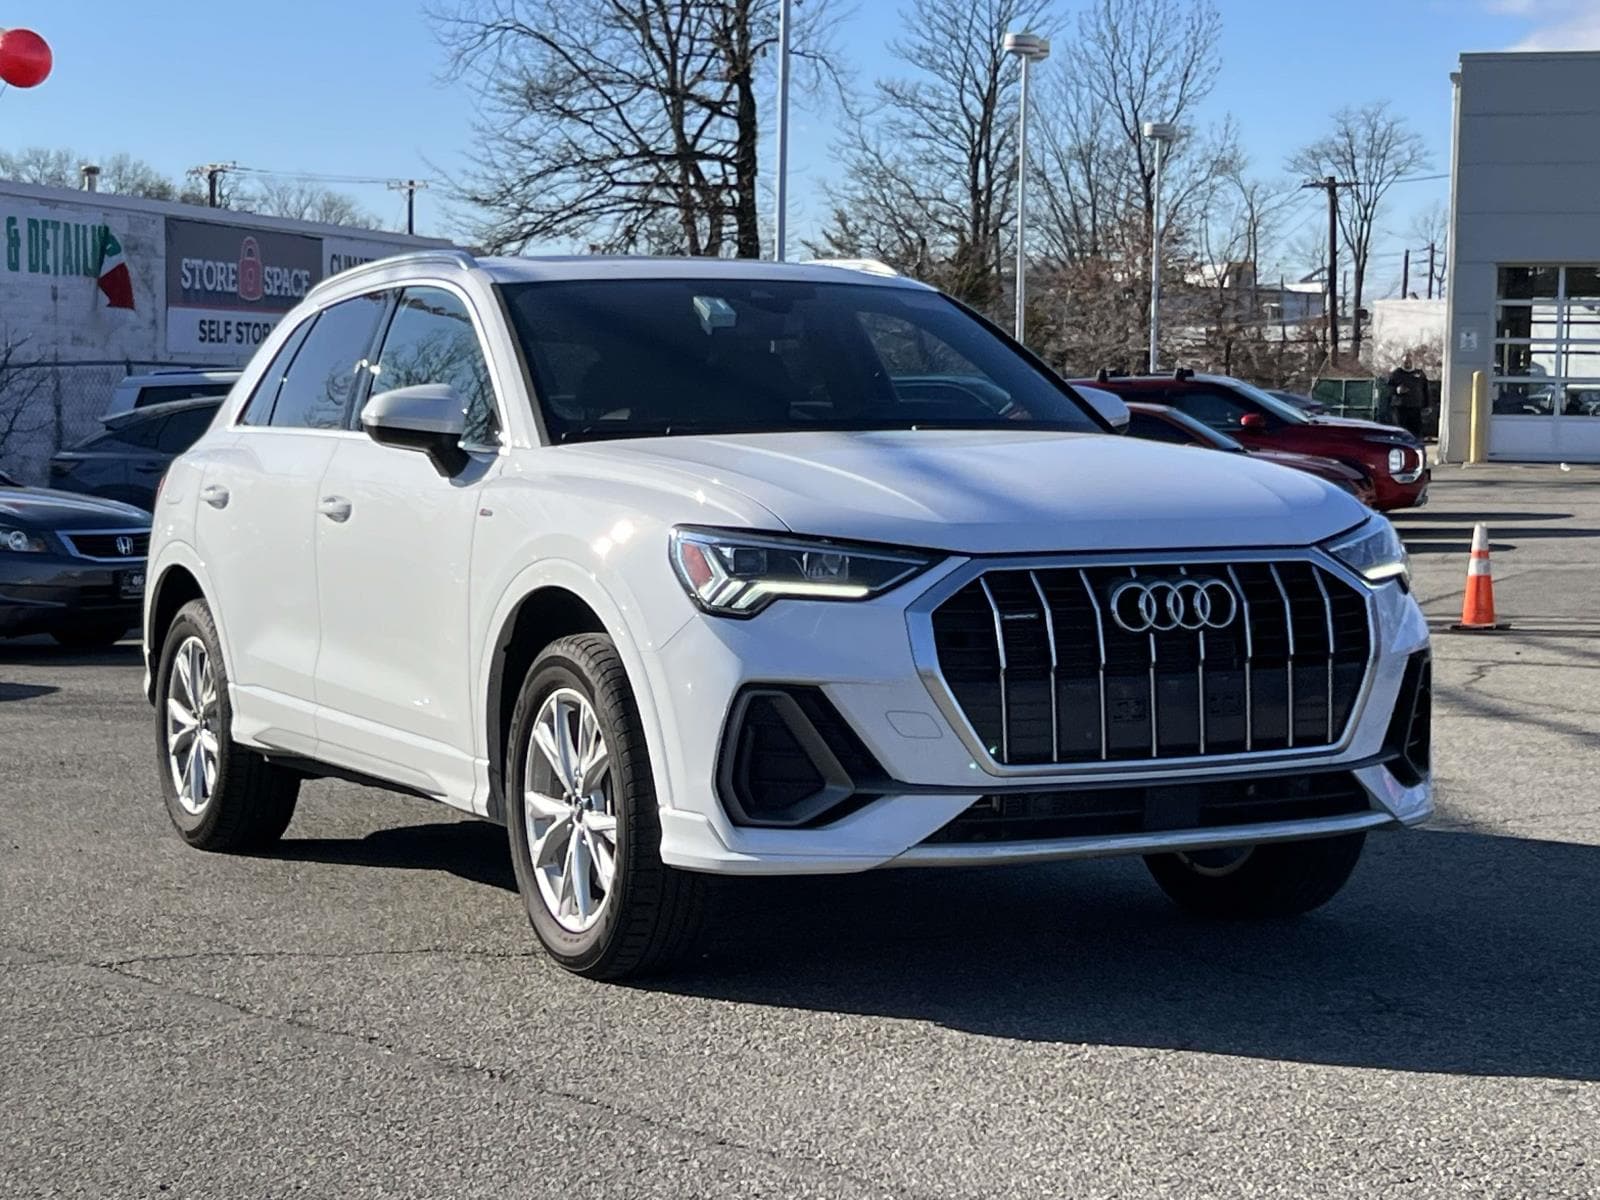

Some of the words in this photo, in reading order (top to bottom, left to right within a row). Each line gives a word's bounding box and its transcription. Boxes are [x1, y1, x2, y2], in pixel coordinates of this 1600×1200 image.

[6, 216, 20, 272] &
[181, 258, 239, 293] STORE
[264, 266, 311, 297] SPACE
[199, 319, 232, 344] SELF
[235, 321, 277, 345] STOR
